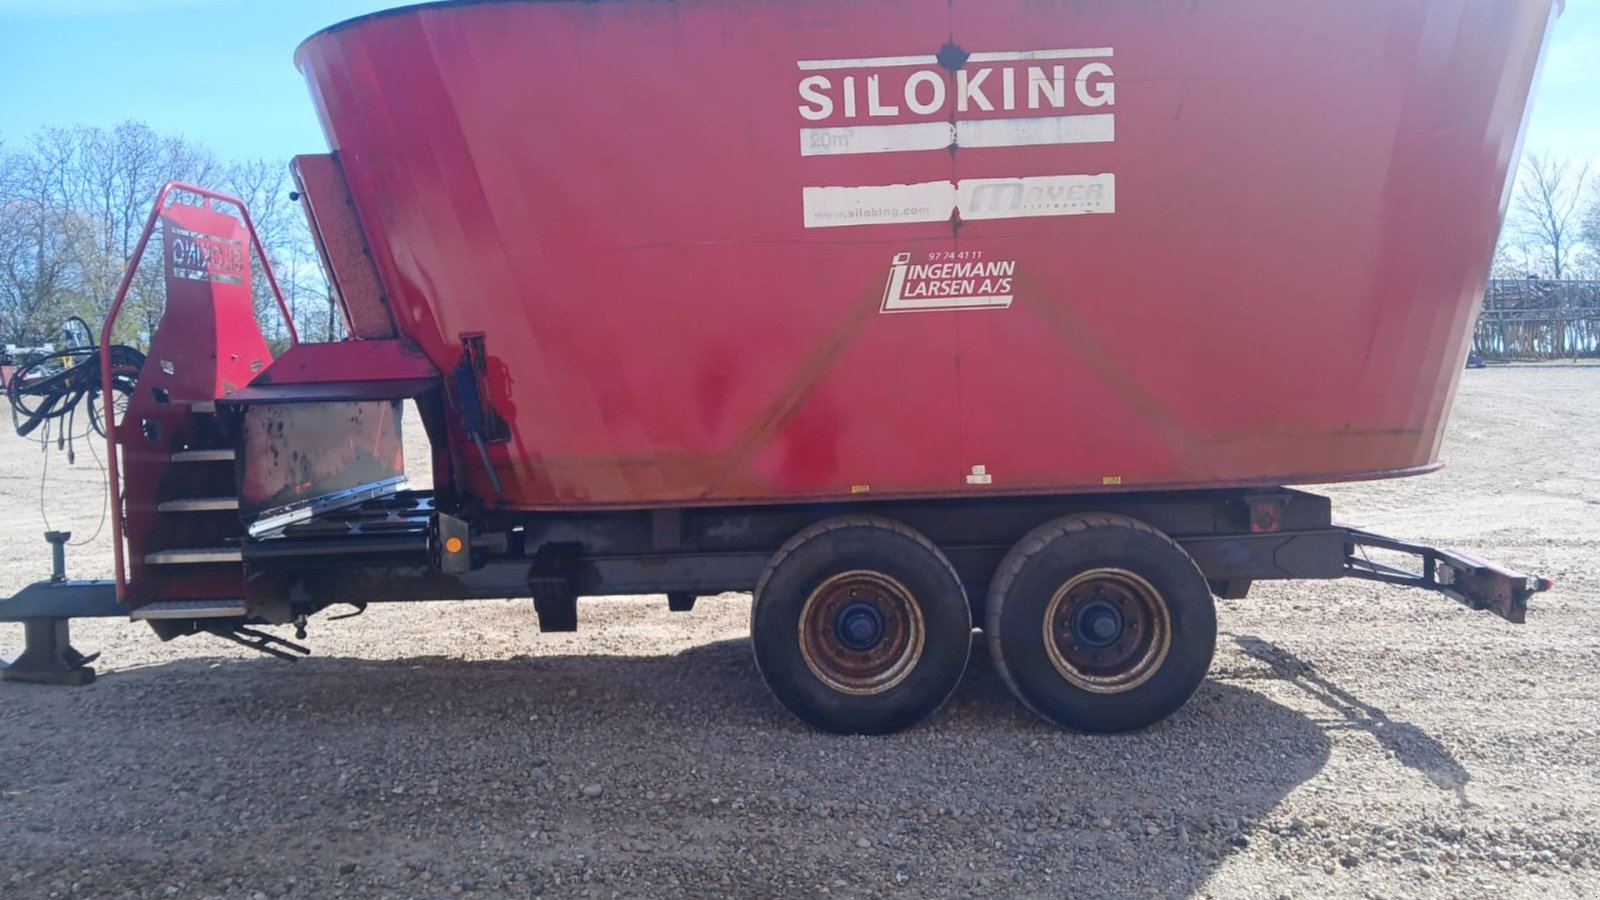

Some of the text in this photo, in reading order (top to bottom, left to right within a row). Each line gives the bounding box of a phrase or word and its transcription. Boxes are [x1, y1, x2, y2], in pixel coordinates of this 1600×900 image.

[798, 62, 1115, 120] SILOKING
[928, 251, 982, 260] 97 74 41 11
[907, 260, 1016, 280] INGEMANN
[904, 278, 1012, 297] LARSEN A/S
